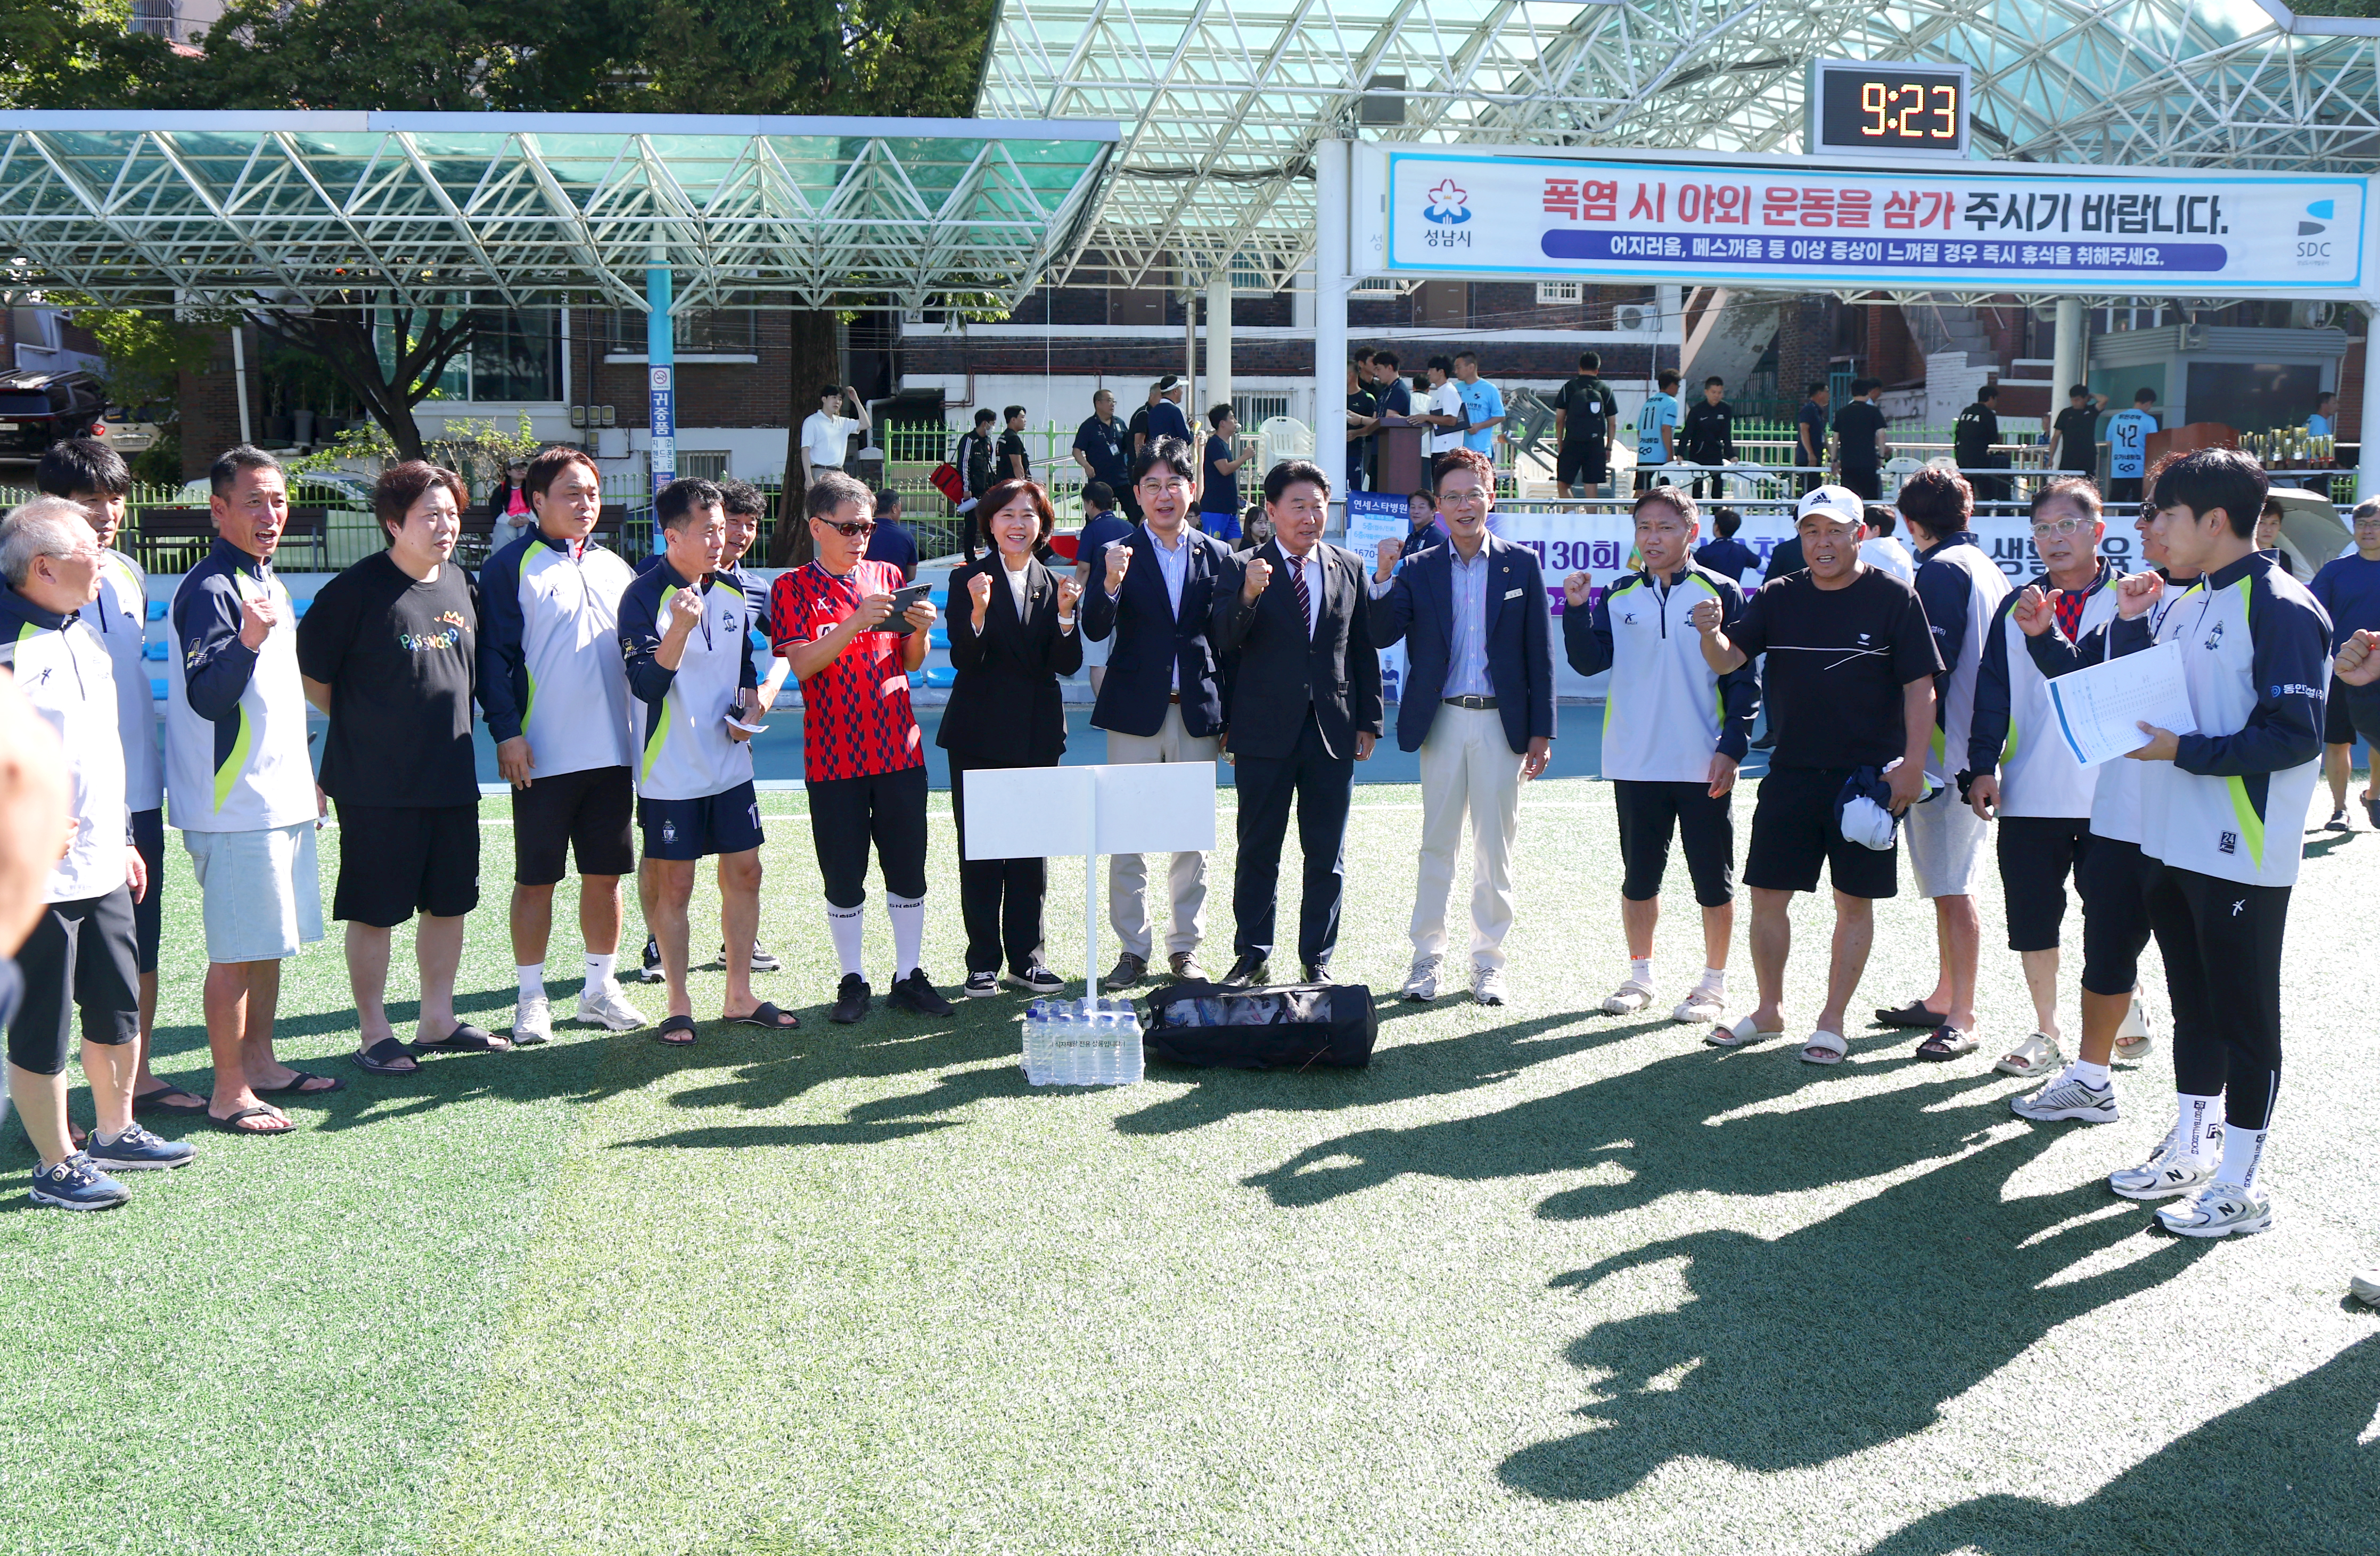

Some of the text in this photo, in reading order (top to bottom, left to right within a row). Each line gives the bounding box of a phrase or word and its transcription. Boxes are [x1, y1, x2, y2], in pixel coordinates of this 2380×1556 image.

[1862, 83, 1956, 138] 9:23
[1543, 178, 2228, 234] 폭염 시 야외 운동을 삼가 주시기 바랍니다.
[1424, 229, 1471, 248] 성남시
[1610, 235, 2165, 266] 어지러움, 메스꺼움 등 이상 증상이 느껴질 경우 즉시 휴식을 취해주세요.
[2297, 242, 2331, 257] SDC
[653, 393, 670, 435] 귀중품
[1643, 406, 1655, 430] 11
[2117, 424, 2138, 447] 42
[653, 449, 673, 458] 핸드폰
[1353, 499, 1408, 514] 연세스타병원
[399, 628, 458, 652] PASSWORD
[872, 632, 899, 641] trucks
[2283, 684, 2324, 700] 동인설(주)
[2222, 833, 2234, 843] 24
[2165, 1169, 2184, 1182] N
[2218, 1203, 2236, 1217] N
